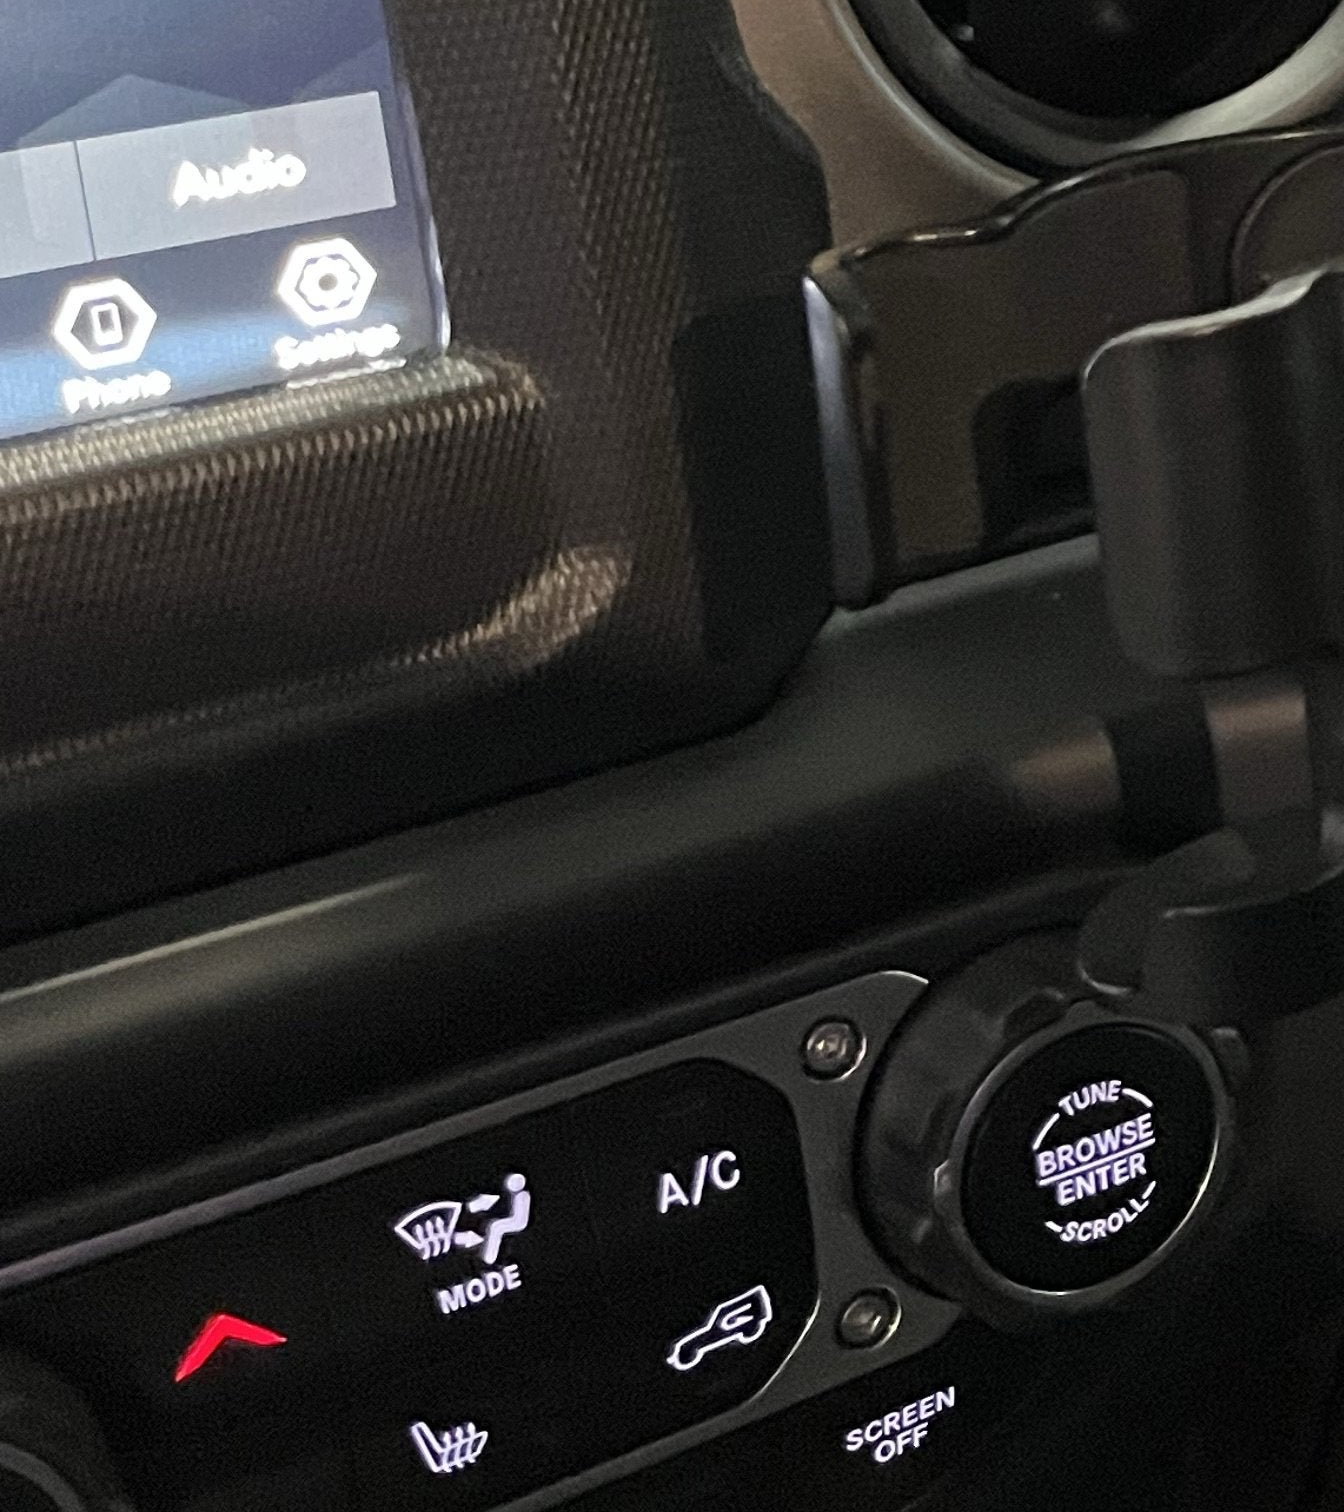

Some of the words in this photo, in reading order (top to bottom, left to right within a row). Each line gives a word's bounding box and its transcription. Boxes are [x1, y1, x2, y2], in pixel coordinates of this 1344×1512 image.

[172, 147, 307, 208] Audio
[1058, 1079, 1122, 1116] TUNE
[1037, 1112, 1154, 1178] BROWSE
[657, 1150, 741, 1215] A/C
[1056, 1152, 1147, 1206] ENTER
[1059, 1198, 1150, 1241] SCROLL
[437, 1263, 523, 1315] MODE
[845, 1385, 956, 1452] SCREEN
[874, 1421, 929, 1463] OFF
